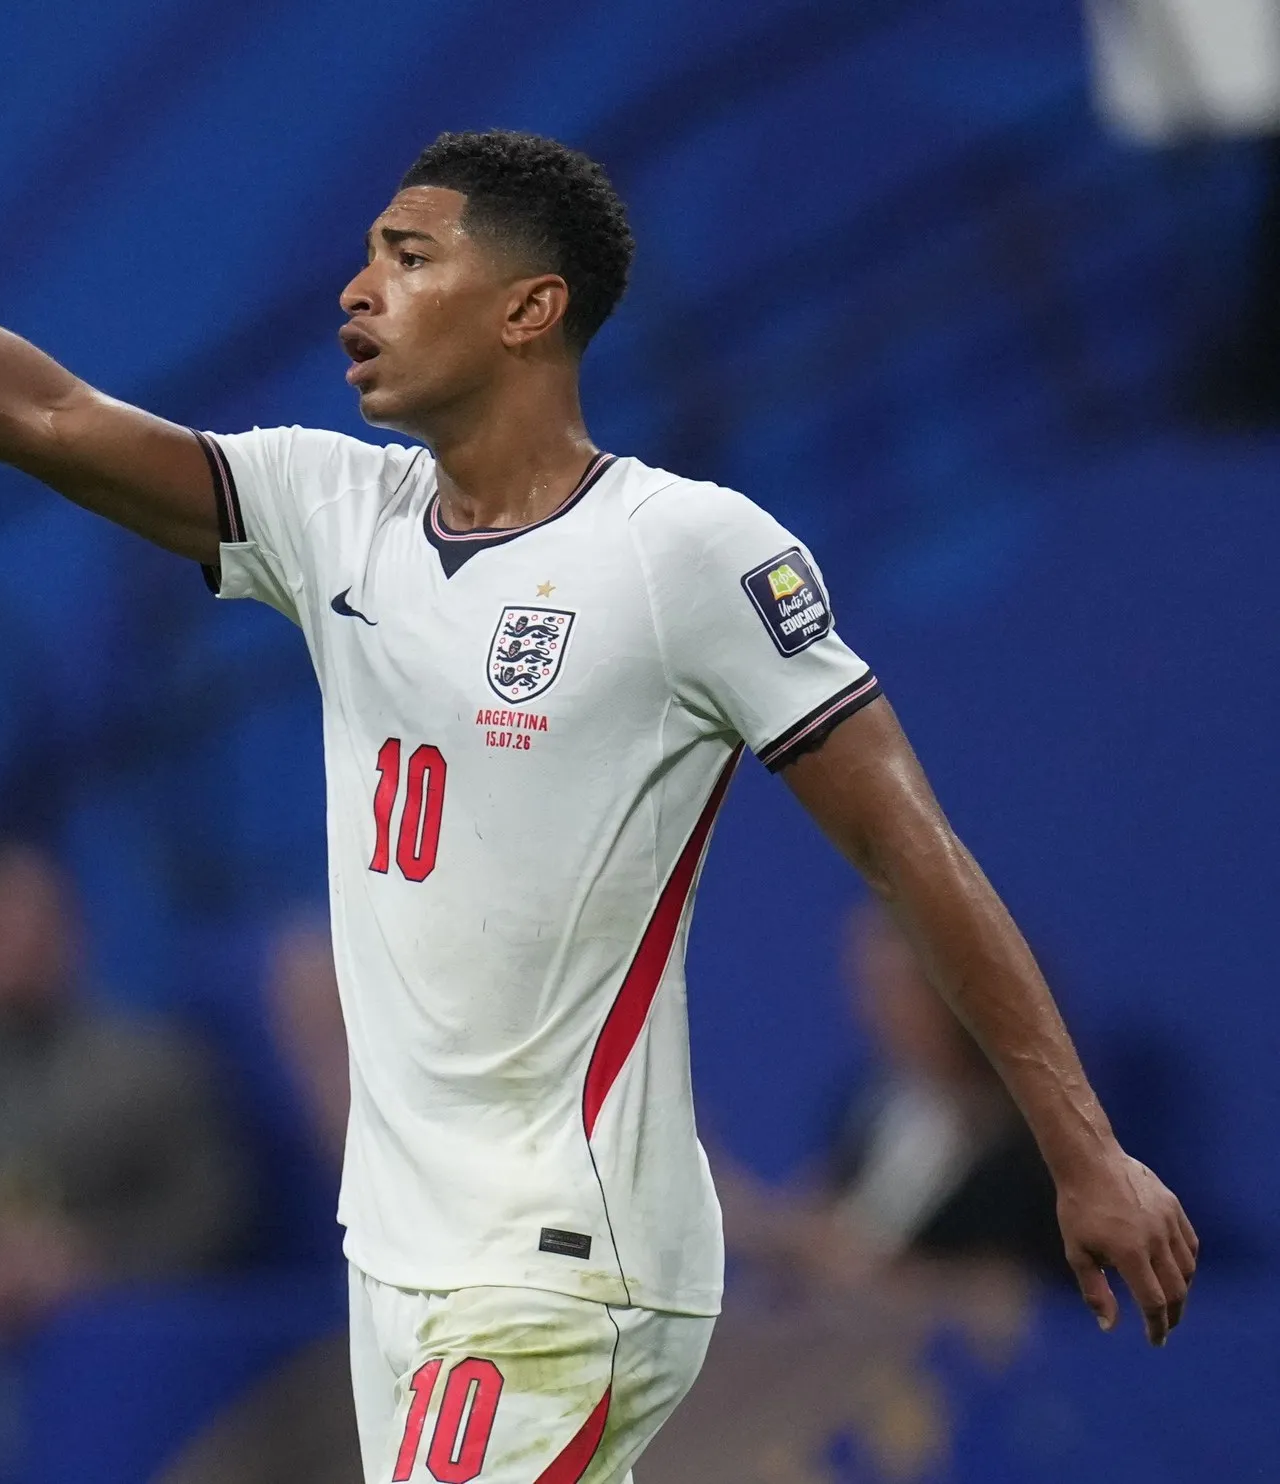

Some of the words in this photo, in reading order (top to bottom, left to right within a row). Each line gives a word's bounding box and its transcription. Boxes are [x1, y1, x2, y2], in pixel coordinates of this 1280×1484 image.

[779, 600, 826, 636] EDUCATION
[802, 622, 821, 637] FIFA
[475, 709, 548, 732] ARGENTINA
[485, 730, 531, 751] 15.07.26
[368, 736, 448, 883] 10
[391, 1356, 505, 1484] 10
